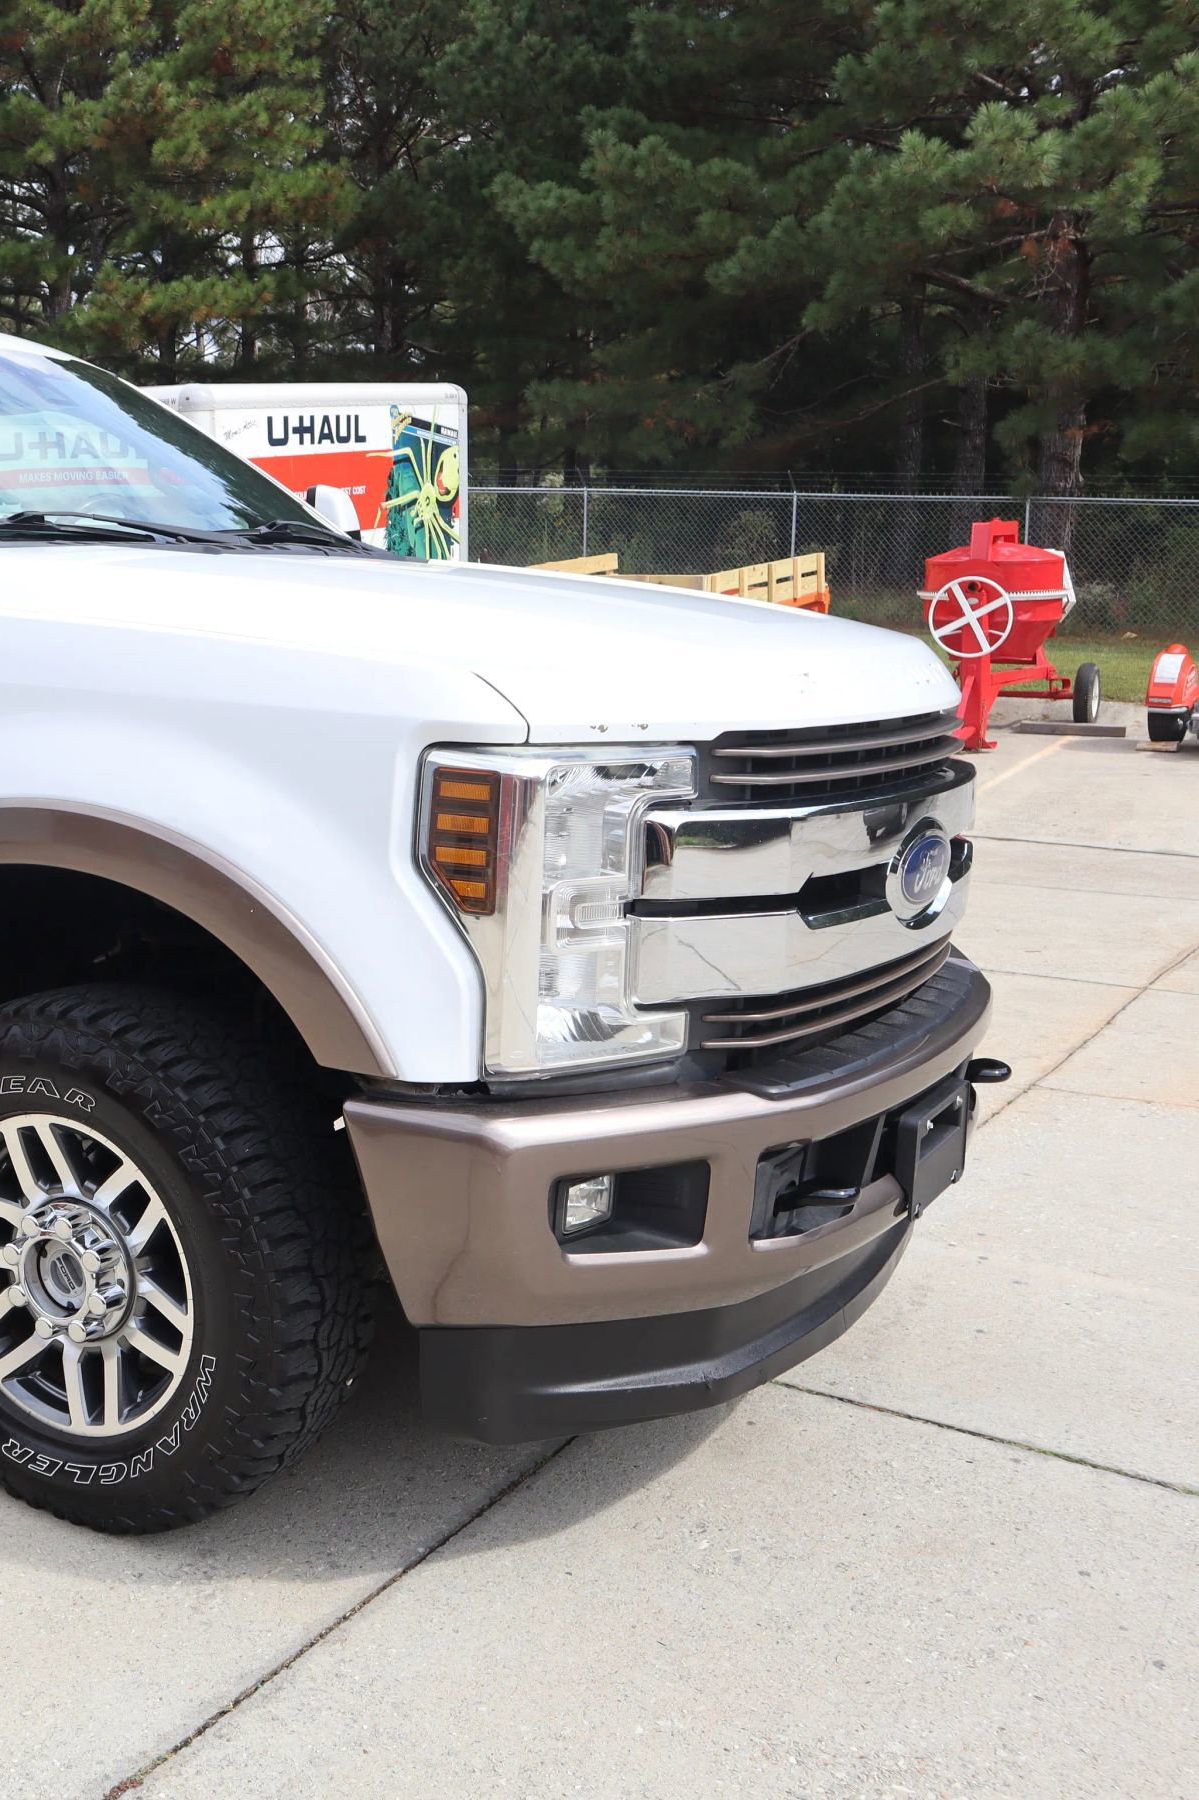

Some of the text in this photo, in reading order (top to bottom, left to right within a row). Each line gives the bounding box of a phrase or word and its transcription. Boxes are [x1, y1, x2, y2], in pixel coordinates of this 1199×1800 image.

[267, 414, 367, 447] U-HAUL
[18, 472, 51, 483] MAKES
[53, 471, 93, 481] MOVING
[352, 485, 367, 495] COST
[1, 1355, 217, 1485] WRANGLER
